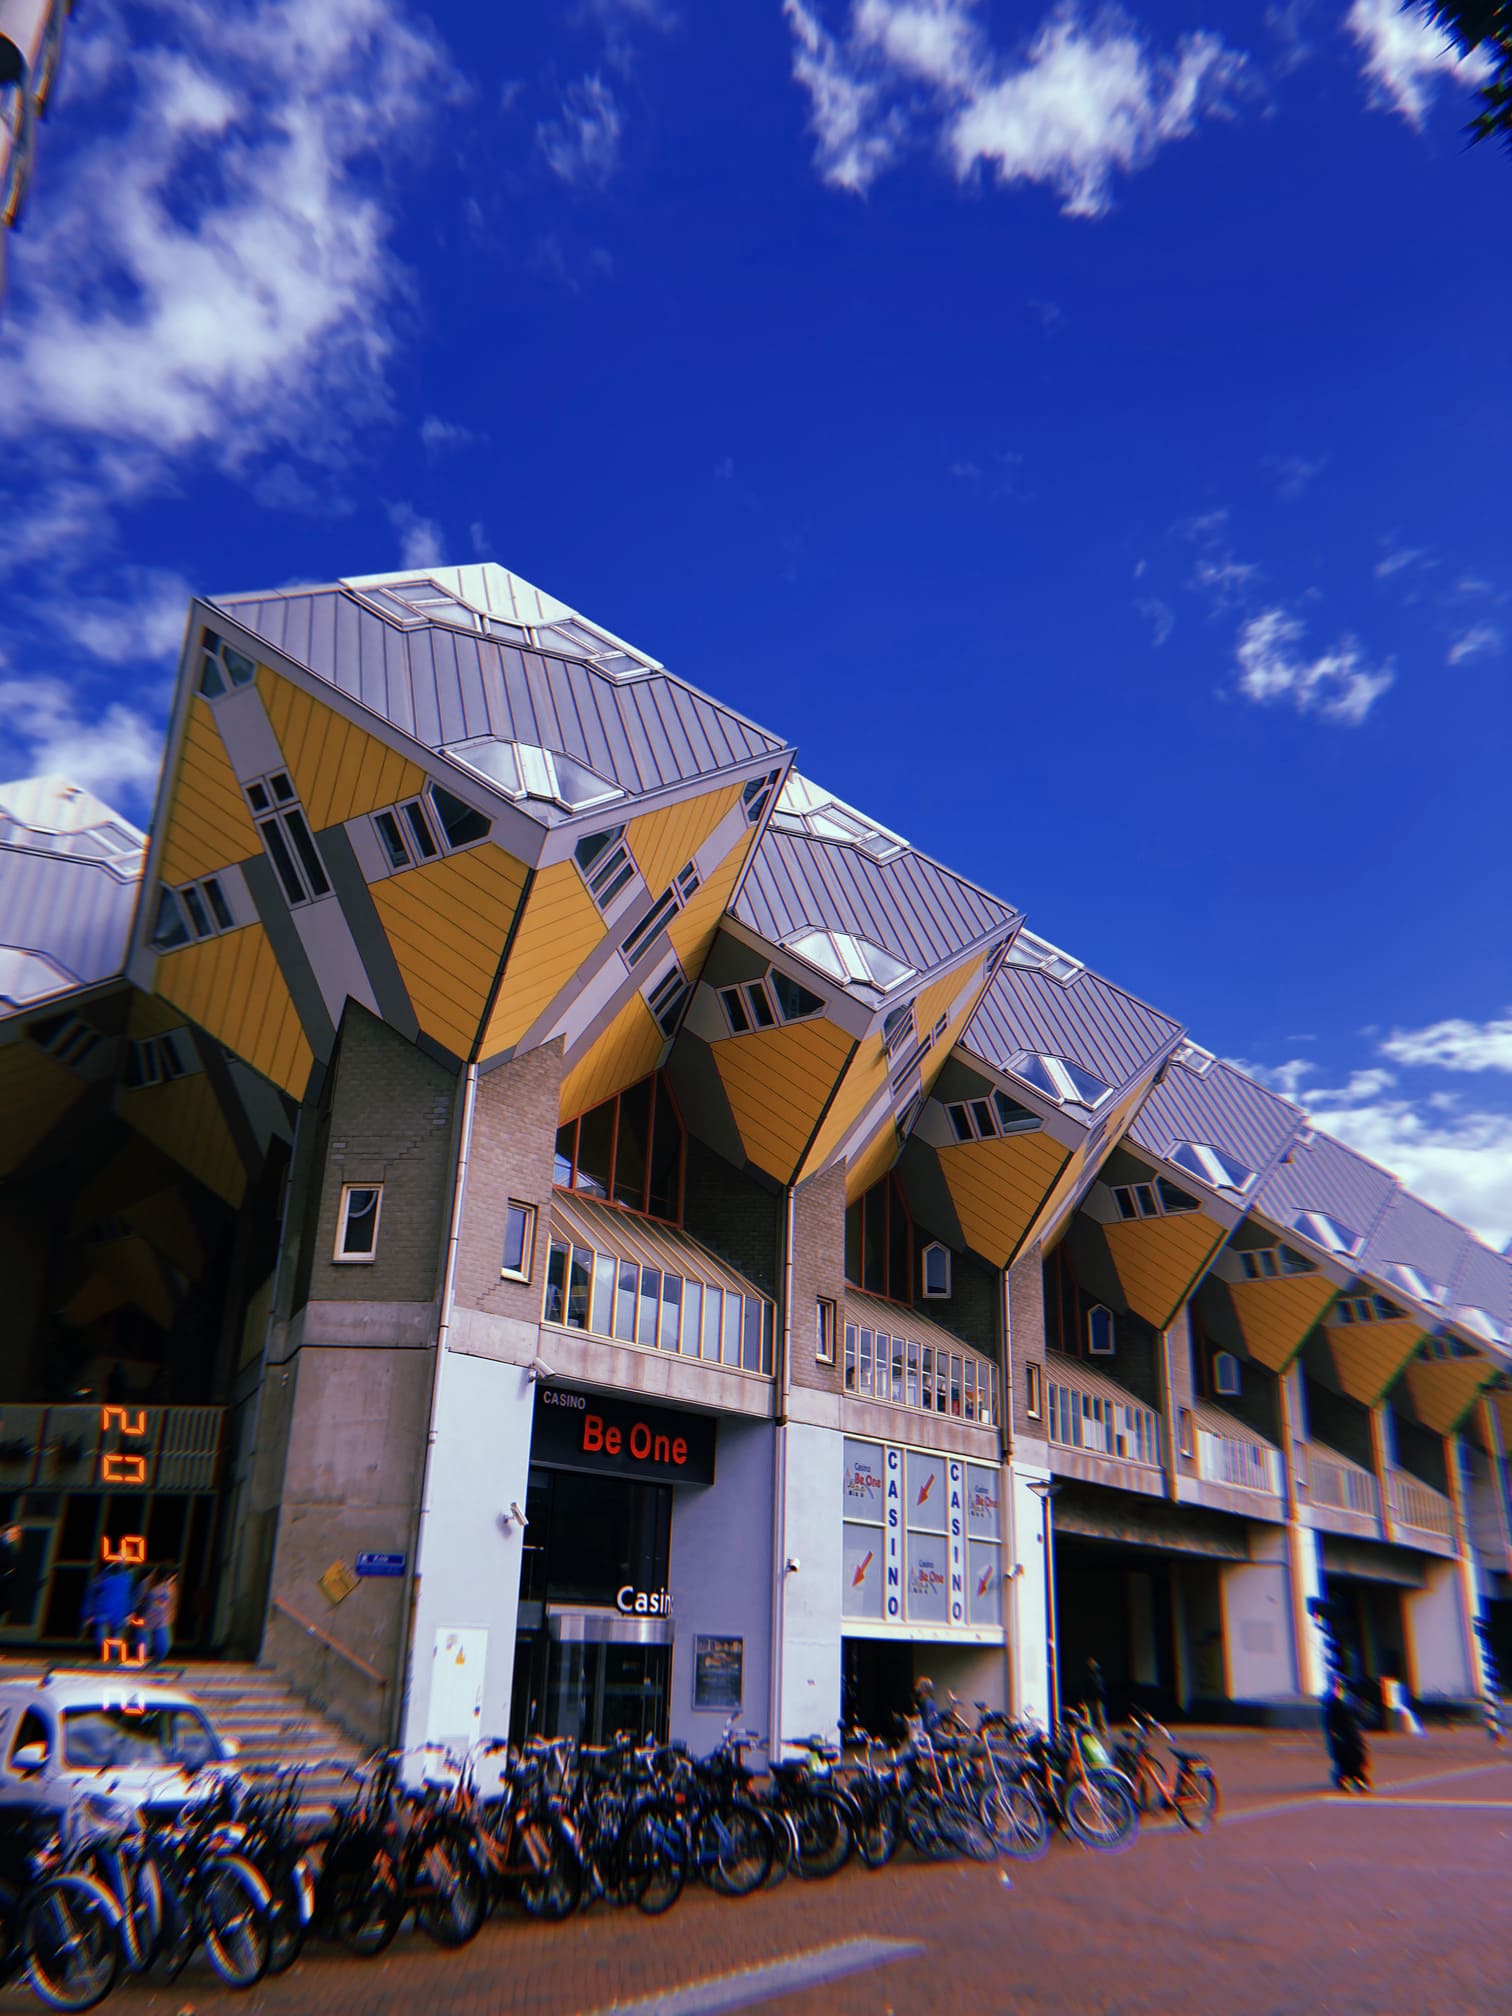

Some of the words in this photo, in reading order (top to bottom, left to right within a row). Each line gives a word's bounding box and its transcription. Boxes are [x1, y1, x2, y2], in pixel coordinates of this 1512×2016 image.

[543, 1391, 586, 1410] CASINO
[582, 1414, 622, 1455] Be
[630, 1423, 688, 1465] One
[855, 1472, 865, 1485] Be
[865, 1475, 882, 1488] One
[888, 1451, 899, 1616] CASINO
[950, 1464, 962, 1620] CASINO
